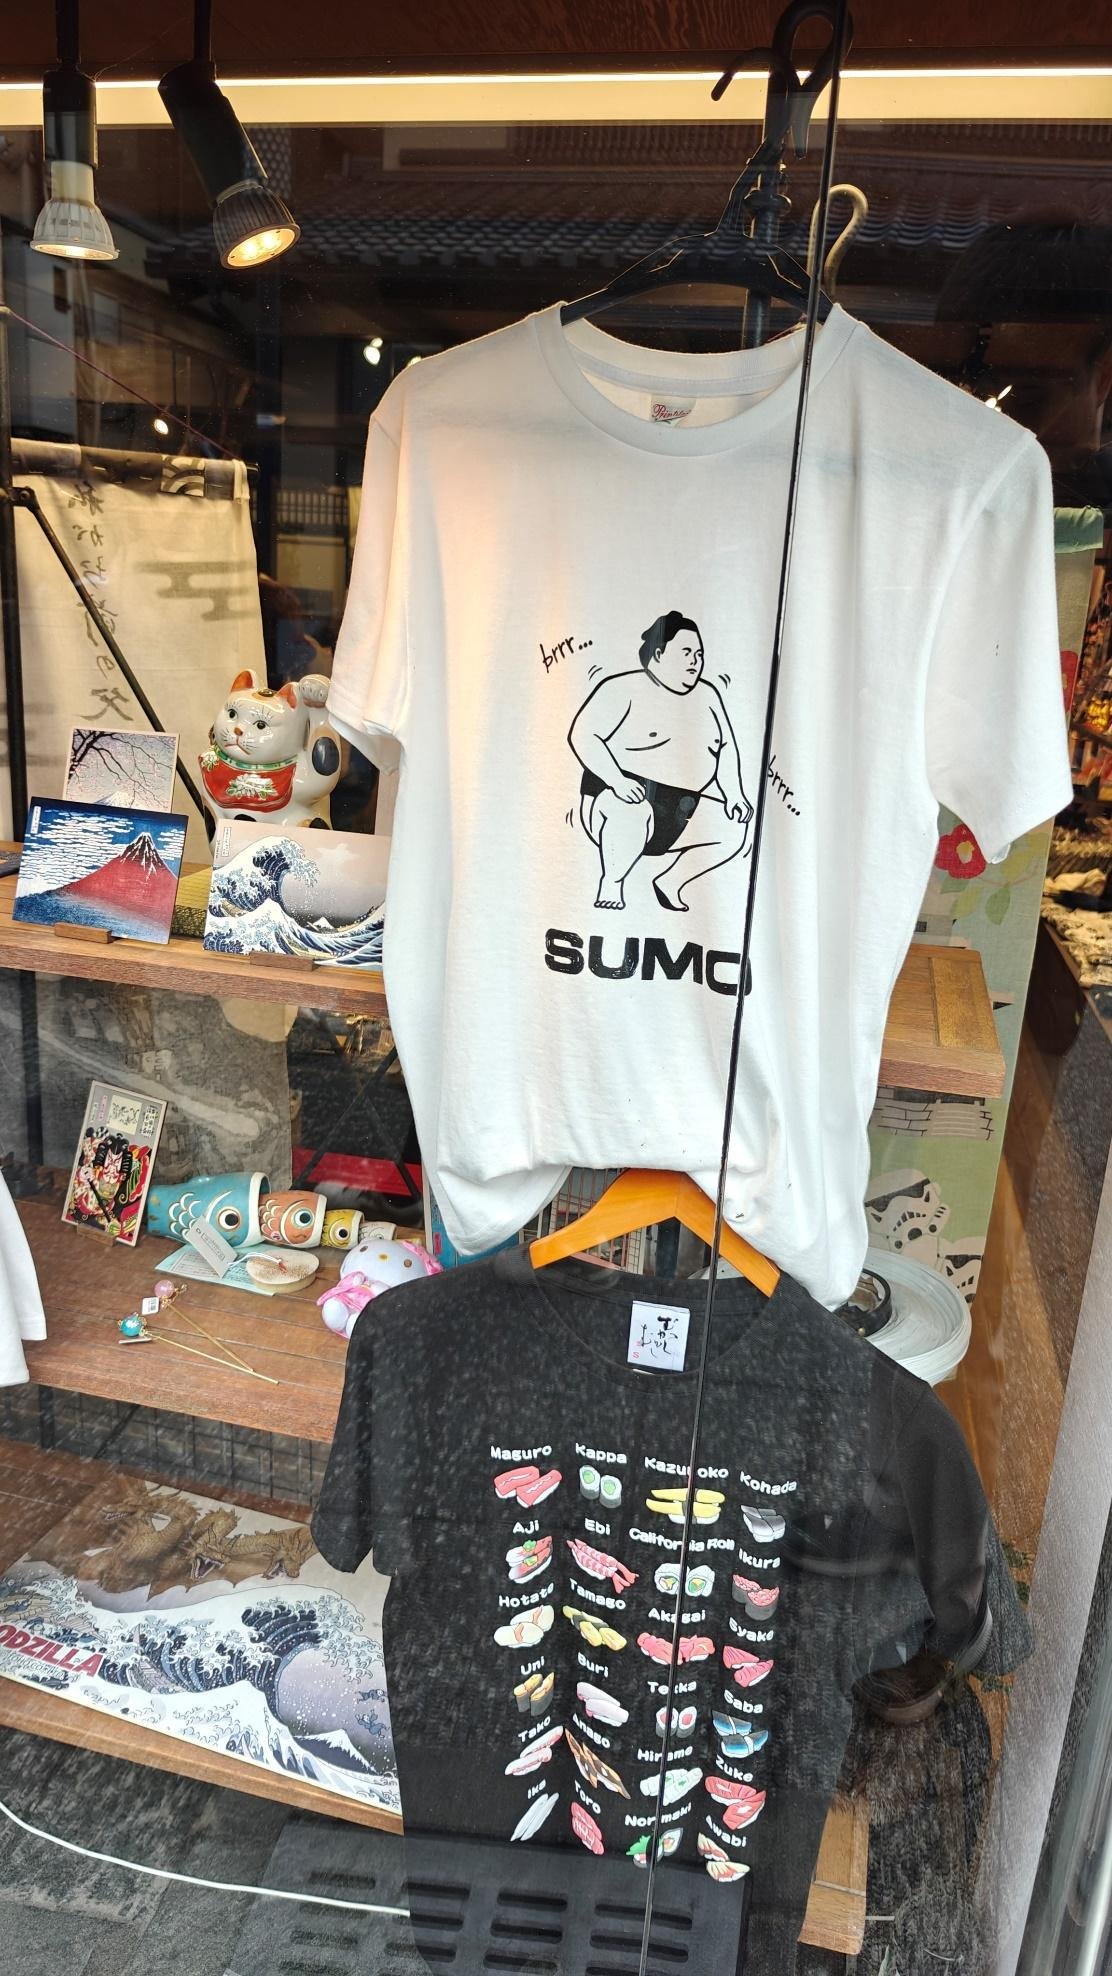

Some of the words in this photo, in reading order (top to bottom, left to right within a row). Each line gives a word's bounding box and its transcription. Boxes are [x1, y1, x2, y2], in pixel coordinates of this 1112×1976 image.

[545, 928, 752, 996] SUMO
[491, 1444, 552, 1461] Maguro
[575, 1443, 627, 1464] Kappa
[645, 1456, 729, 1479] Kazuoko
[740, 1471, 797, 1495] Kohada
[513, 1520, 540, 1534] Aji
[584, 1518, 611, 1535] Ebi
[629, 1527, 704, 1552] Califoria
[706, 1538, 735, 1551] Roll
[739, 1548, 780, 1569] Ikura
[499, 1583, 554, 1608] Hotate
[569, 1578, 626, 1610] Tamago
[0, 1624, 104, 1677] ODZILLA
[520, 1656, 545, 1675] Uni
[577, 1652, 609, 1677] Buri
[724, 1690, 763, 1713] Saba
[518, 1716, 551, 1742] Tako
[573, 1713, 611, 1748] Anago
[716, 1755, 753, 1782] Zuke
[527, 1780, 546, 1799] Ika
[574, 1780, 601, 1814] Toro
[625, 1803, 691, 1827] Normaki
[705, 1816, 747, 1847] Awabi
